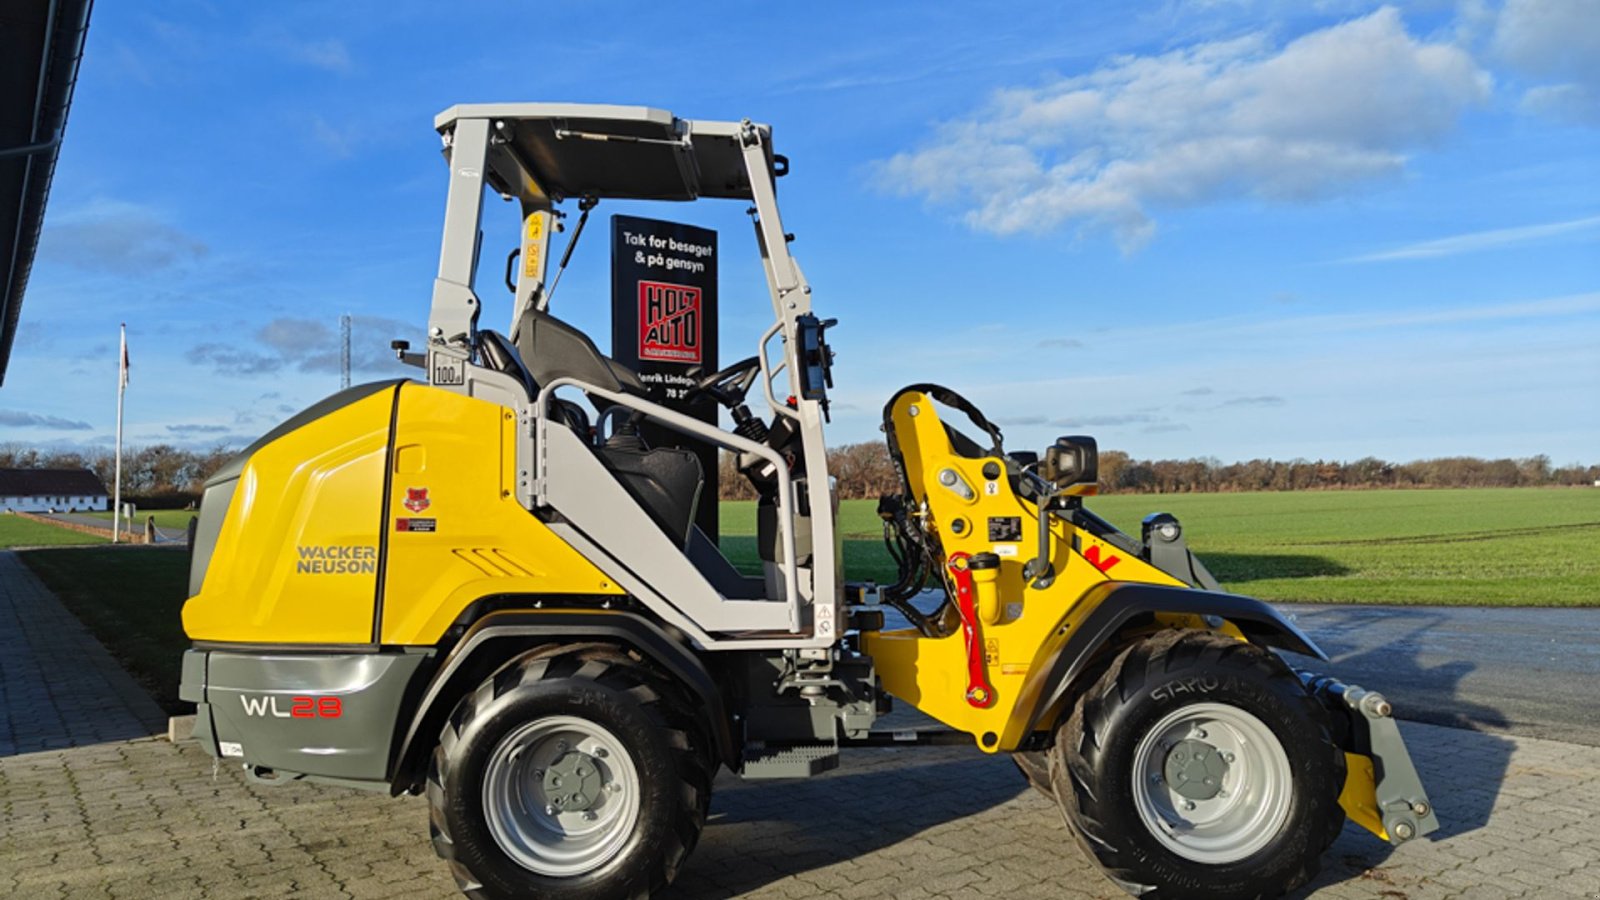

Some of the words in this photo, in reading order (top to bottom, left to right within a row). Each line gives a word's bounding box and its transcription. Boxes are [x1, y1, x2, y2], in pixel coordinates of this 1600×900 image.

[623, 231, 646, 245] Tak
[648, 235, 667, 249] for
[669, 238, 712, 257] besøget
[635, 250, 646, 264] &
[647, 253, 664, 268] på
[666, 256, 704, 273] gensyn
[647, 286, 697, 325] HOLT
[644, 309, 697, 347] AUTO
[437, 366, 455, 382] 100
[297, 546, 376, 559] WACKER
[297, 560, 375, 574] NEUSON
[240, 694, 342, 718] WL28
